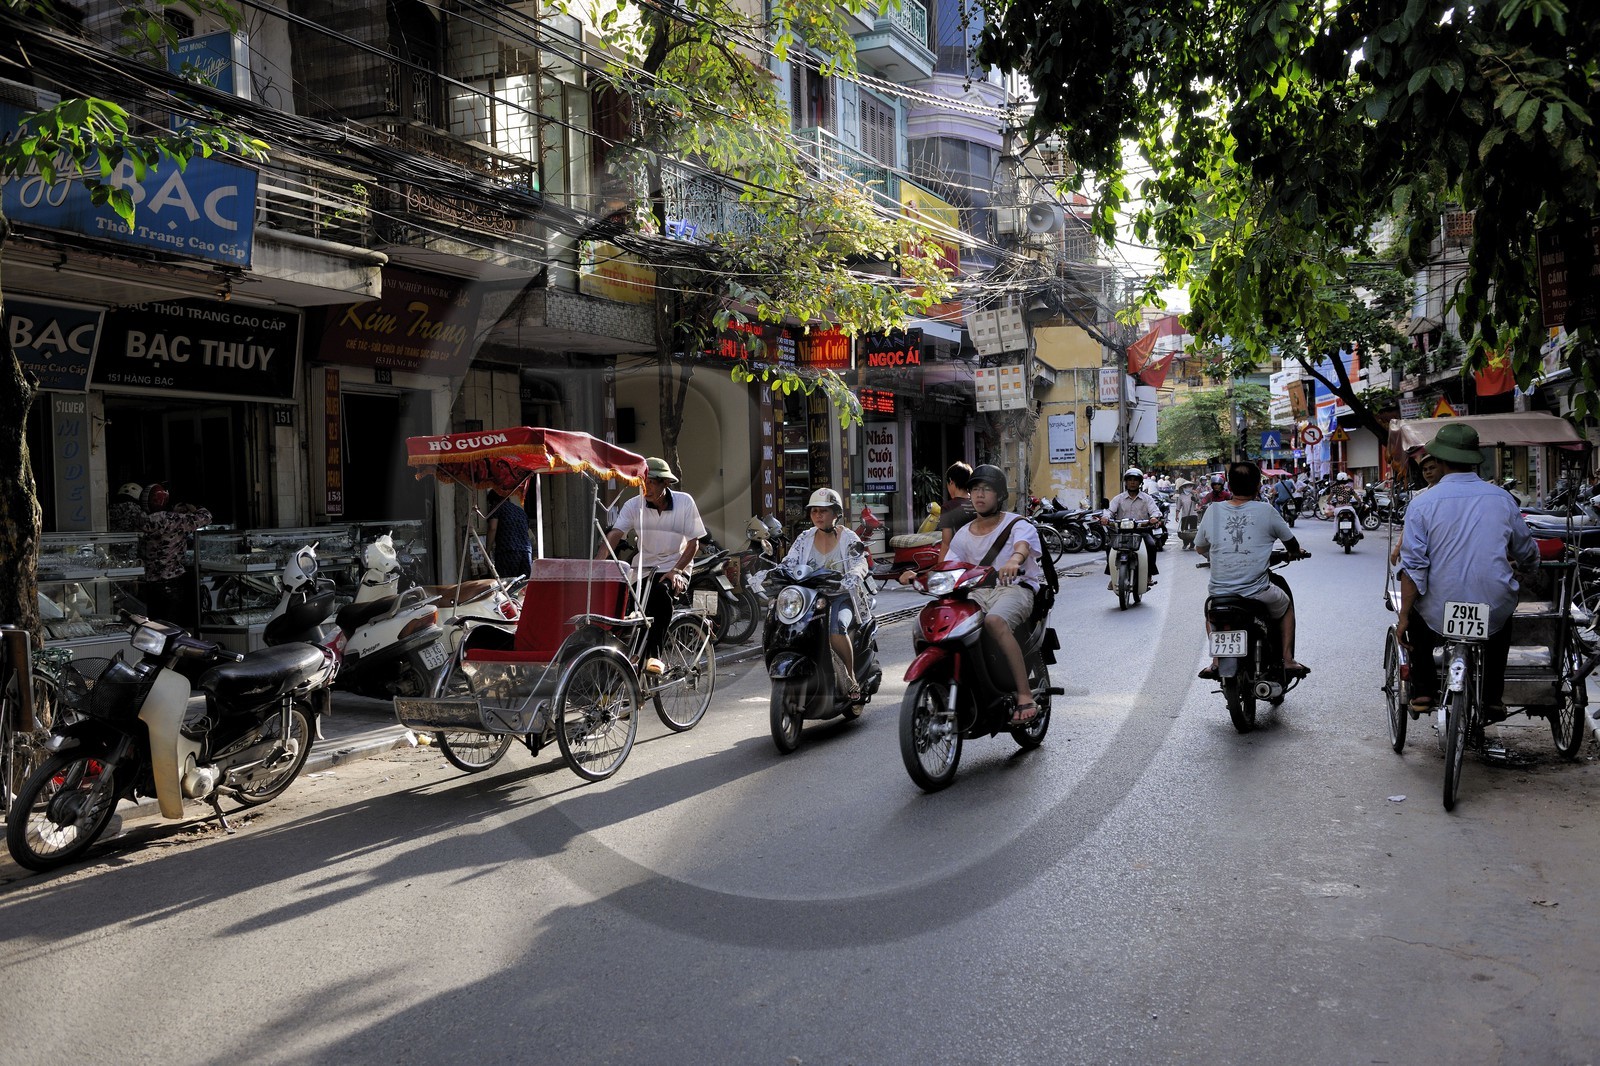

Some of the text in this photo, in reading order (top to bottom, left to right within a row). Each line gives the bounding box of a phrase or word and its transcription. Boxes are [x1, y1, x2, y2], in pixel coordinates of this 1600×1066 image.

[138, 226, 185, 248] Trang
[188, 236, 215, 252] Cao
[218, 241, 246, 259] Cấp
[187, 308, 230, 324] TRANG
[233, 314, 259, 328] CAO
[262, 317, 287, 332] CẤP
[339, 301, 467, 356] Kim Trang
[9, 315, 94, 360] BẠC
[126, 329, 275, 371] BẠC THÚY
[869, 350, 905, 369] NGỌC
[107, 373, 174, 388] 151 HÀNG BẠC
[377, 370, 391, 382] 153
[1101, 387, 1118, 396] LON
[56, 400, 84, 414] SILVER
[276, 411, 291, 424] 151
[428, 433, 508, 451] HỒ GƯƠM
[865, 426, 893, 446] Nhẫn
[868, 447, 892, 463] Cưới
[868, 467, 886, 480] NGỌC
[327, 491, 341, 502] 153
[1452, 604, 1481, 621] 29XL
[1447, 619, 1485, 636] 0175
